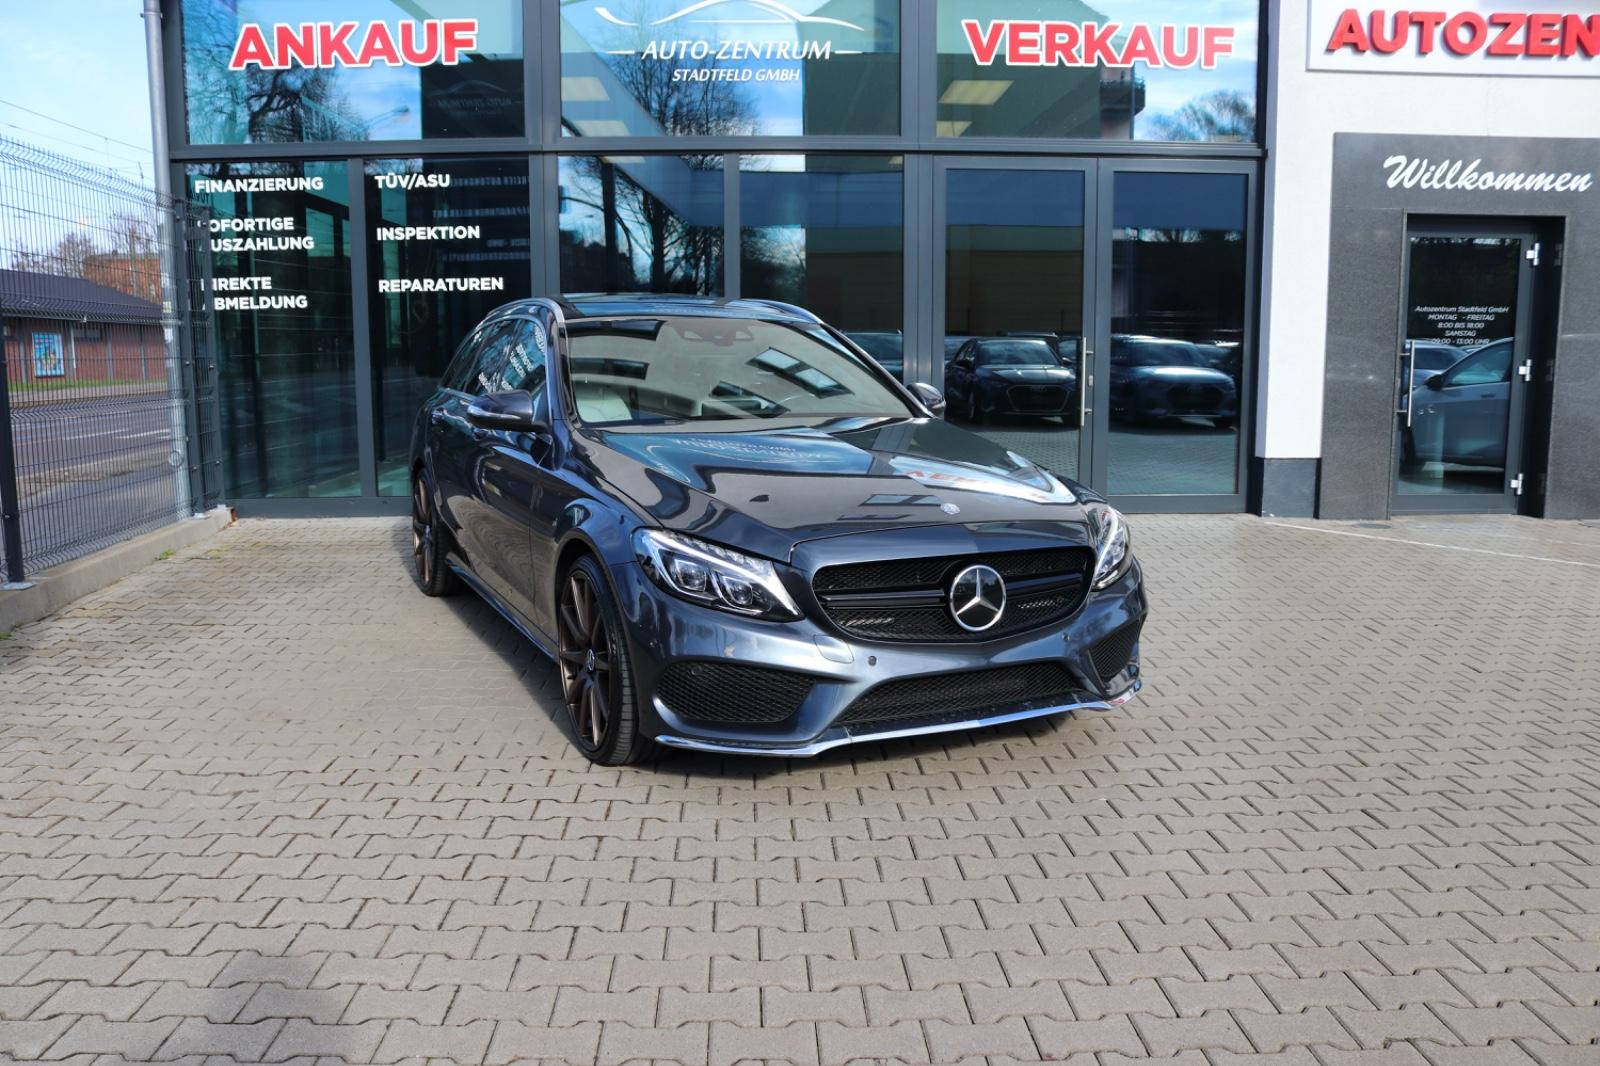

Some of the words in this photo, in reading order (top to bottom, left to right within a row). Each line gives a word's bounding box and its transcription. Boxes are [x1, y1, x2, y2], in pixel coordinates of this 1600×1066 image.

[1328, 9, 1600, 57] AUTOZEN
[229, 18, 479, 71] ANKAUF
[641, 40, 831, 60] AUTO-ZENTRUM
[962, 19, 1236, 70] VERKAUF
[672, 69, 752, 82] STADTFELD
[755, 68, 800, 82] GMBH
[375, 173, 450, 190] TÜV/ASU
[1383, 155, 1594, 192] Willkommen
[194, 176, 325, 194] FINANZIERUNG
[197, 217, 294, 233] OFORTIGE
[376, 226, 480, 241] INSPEKTION
[199, 236, 315, 252] USZAHLUNG
[378, 277, 503, 293] REPARATUREN
[202, 295, 308, 311] BMELDUNG
